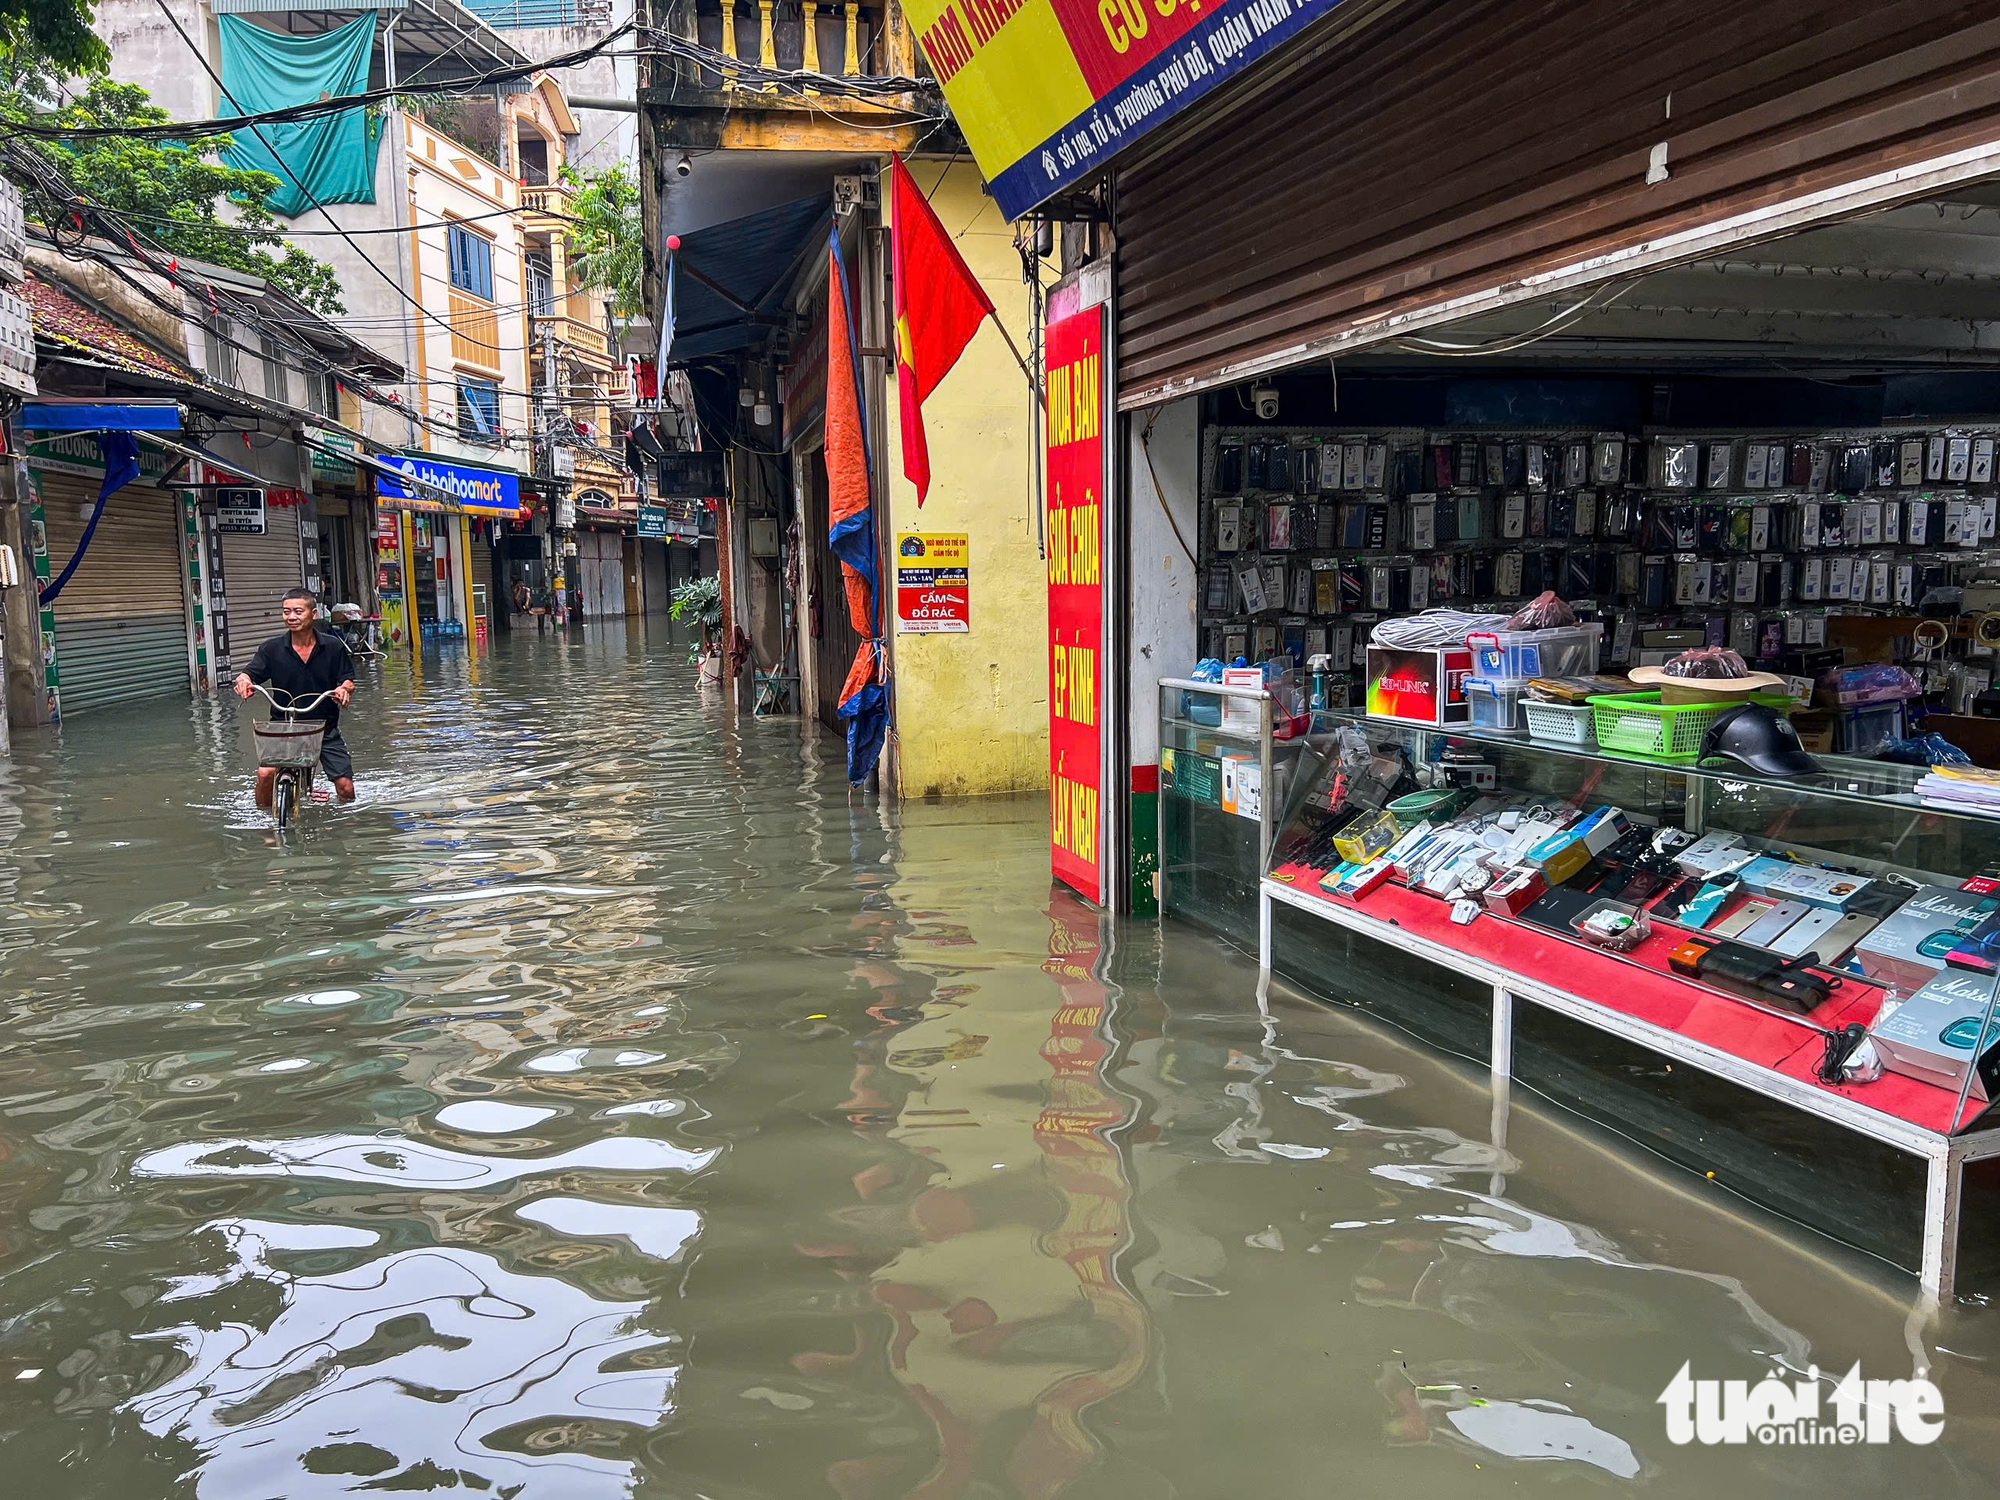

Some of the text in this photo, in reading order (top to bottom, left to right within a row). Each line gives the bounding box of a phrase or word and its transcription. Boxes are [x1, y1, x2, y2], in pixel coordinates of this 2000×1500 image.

[921, 4, 975, 86] NAM
[1057, 133, 1076, 169] SỐ
[1071, 130, 1098, 160] 109,
[1090, 108, 1109, 147] TỔ
[1104, 114, 1122, 137] 4,
[1114, 83, 1164, 130] PHƯỜNG
[1157, 54, 1189, 100] PHÚ
[1184, 40, 1214, 81] ĐÔ,
[1208, 16, 1253, 66] QUẬN
[1247, 0, 1292, 37] NAM
[1047, 338, 1098, 448] MUA BÁN
[1049, 482, 1099, 586] SỬA CHỮA
[912, 604, 955, 618] ĐỔ RÁC
[920, 590, 946, 604] CẤM
[1054, 628, 1094, 727] ÉP KÍNH
[1052, 750, 1097, 865] LẤY NGAY
